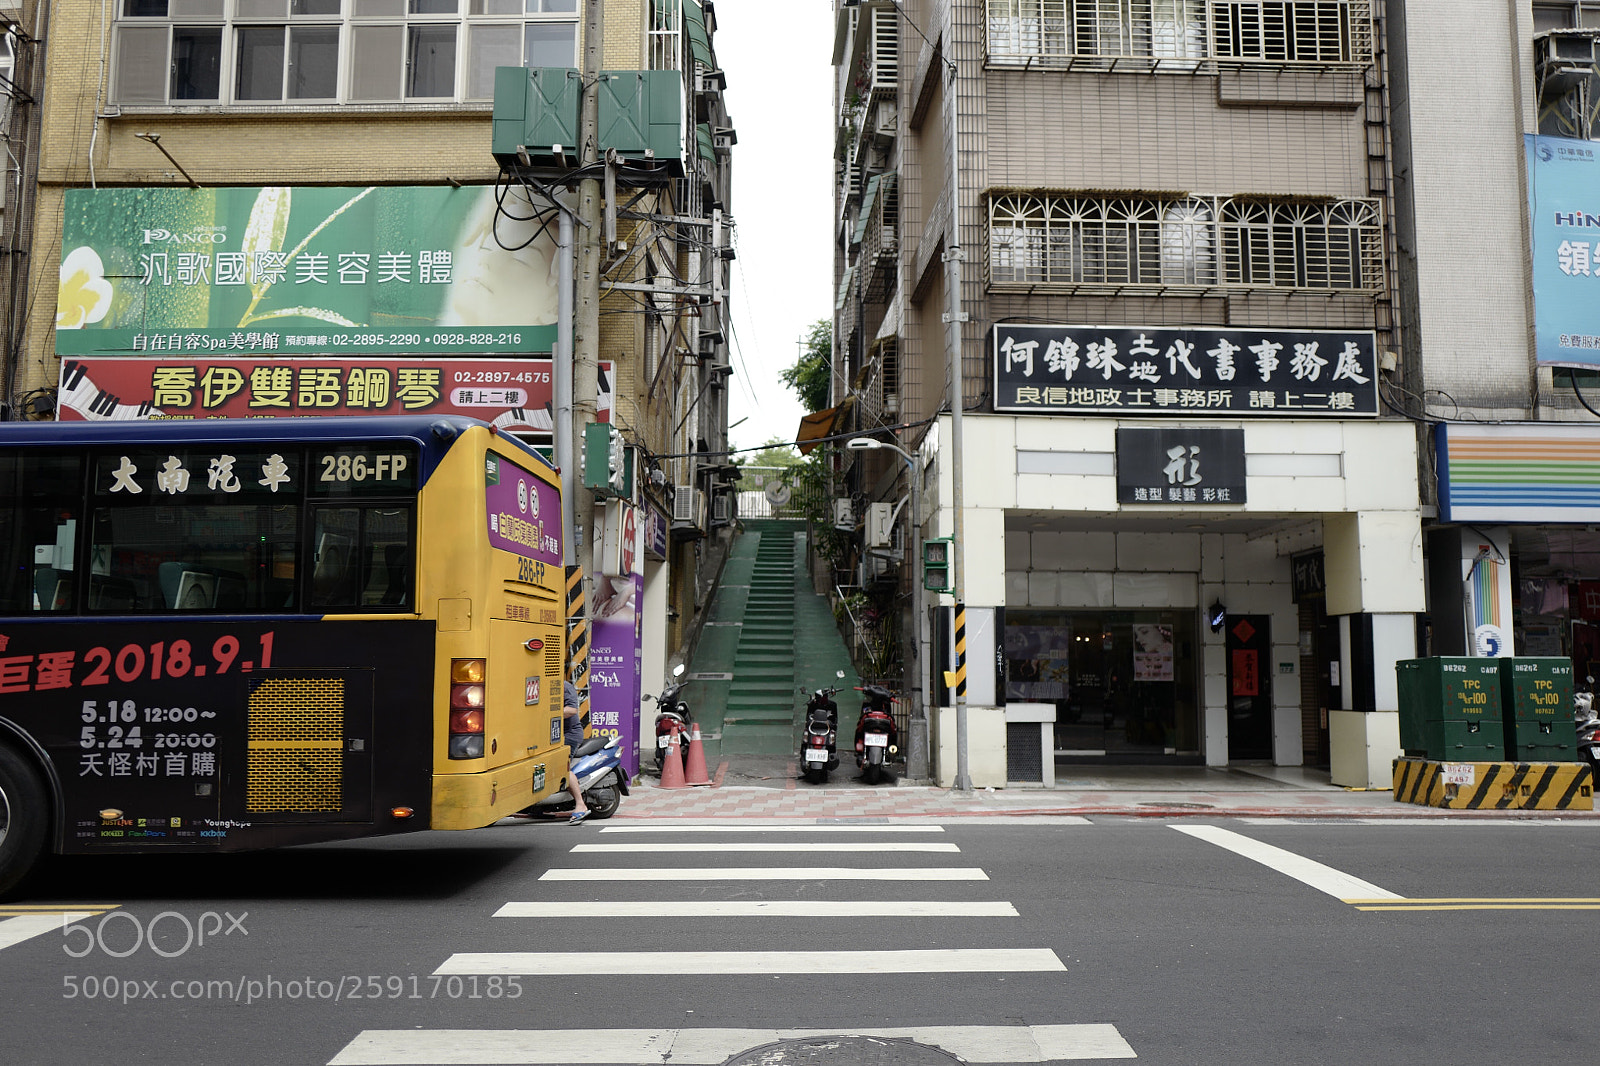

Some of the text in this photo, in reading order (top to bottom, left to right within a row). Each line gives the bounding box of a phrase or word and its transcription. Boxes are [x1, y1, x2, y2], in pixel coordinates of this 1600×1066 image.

[140, 250, 453, 286] 汎歌國際美容美體
[1557, 240, 1600, 277] 領
[332, 333, 420, 347] 02-2895-2290
[433, 332, 522, 346] 0928-828-216
[152, 366, 441, 409] 喬伊雙語鋼琴
[454, 371, 550, 384] 02-2897-4575
[459, 390, 520, 405] 請上二樓
[1015, 387, 1355, 410] 良信地政士事務所 請上二樓
[109, 453, 292, 495] 大南汽車
[320, 454, 407, 482] 286-FP
[518, 556, 545, 584] 286-FP
[81, 631, 274, 687] 2018.9.1
[1462, 680, 1480, 690] TPC
[1534, 680, 1553, 690] TPC
[81, 700, 137, 723] 5.18
[79, 726, 216, 749] 5.24 20:00
